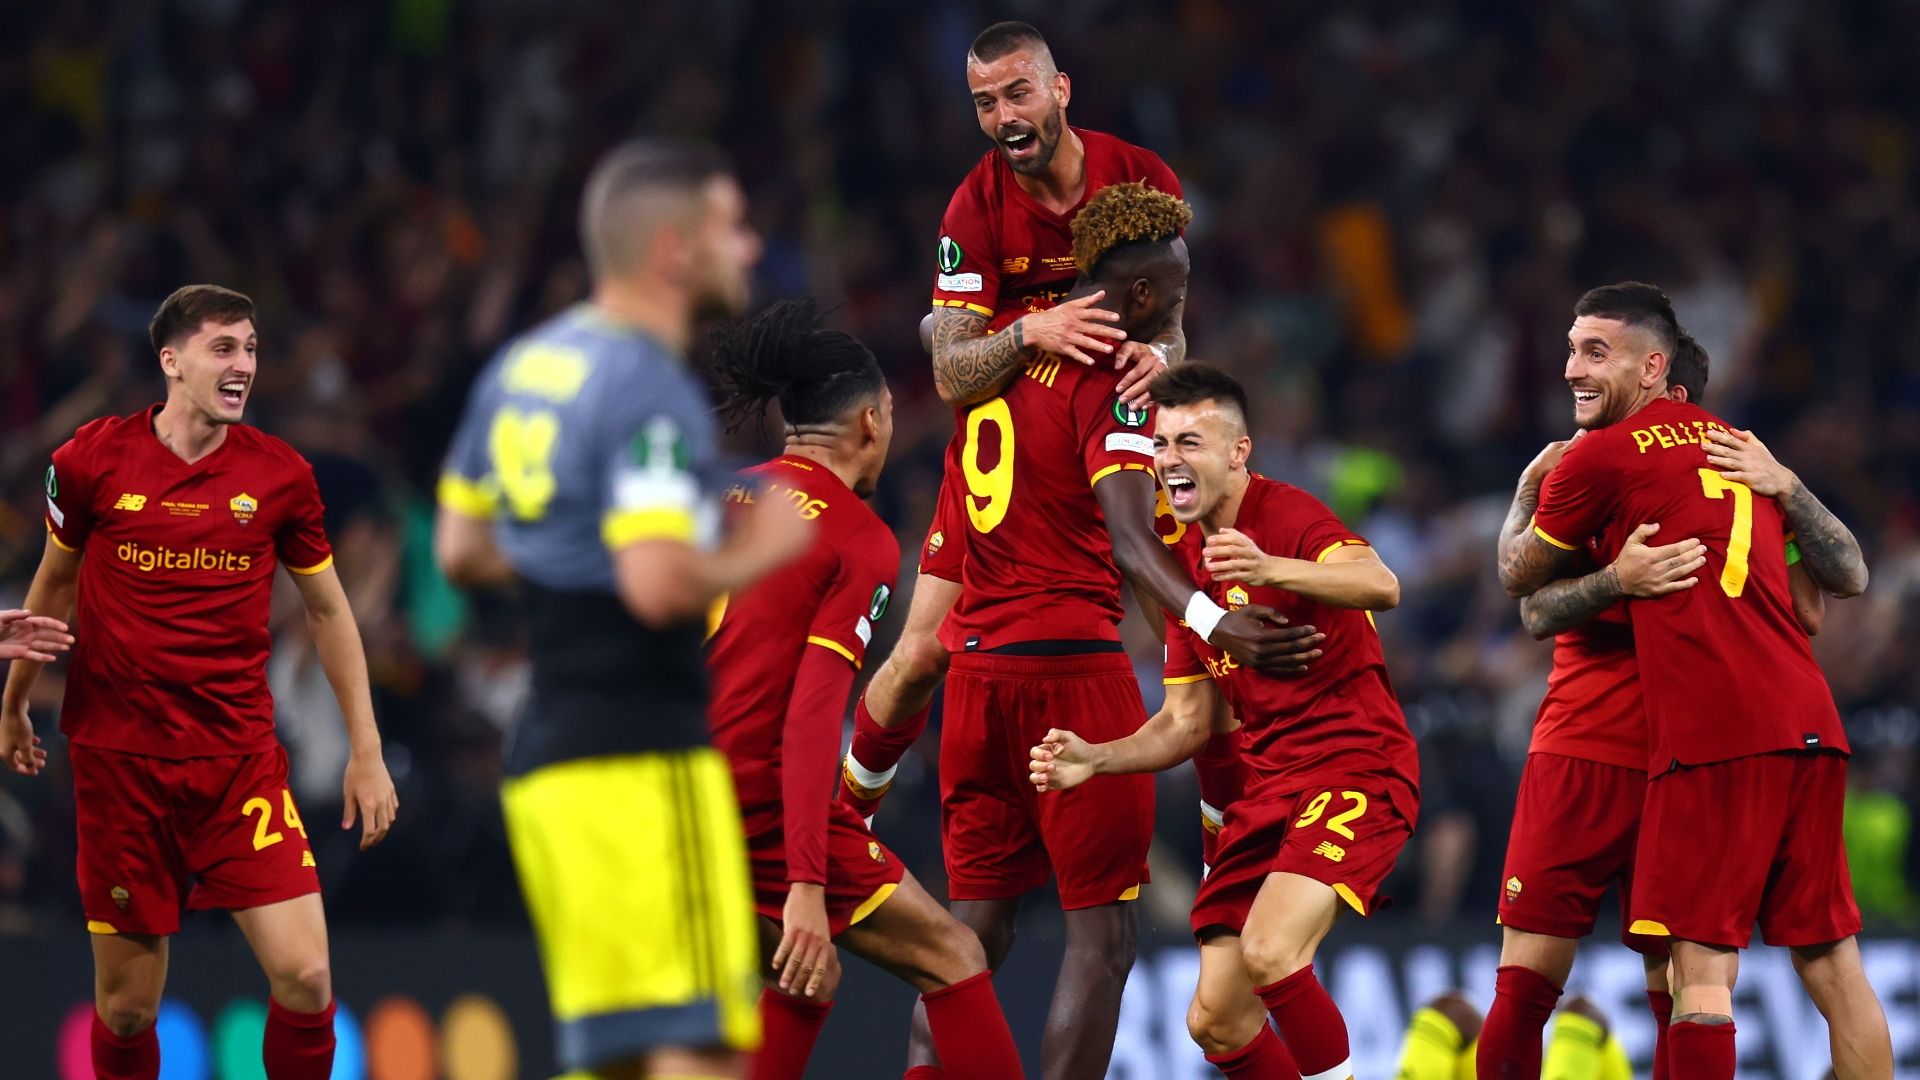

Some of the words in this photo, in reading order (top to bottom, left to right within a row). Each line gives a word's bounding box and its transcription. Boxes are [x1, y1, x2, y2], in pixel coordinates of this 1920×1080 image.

[1631, 421, 1729, 453] PELLE
[962, 397, 1015, 534] 9
[118, 542, 251, 571] digitalbits
[1698, 468, 1752, 598] 7
[242, 789, 307, 850] 24
[1295, 791, 1367, 841] 92
